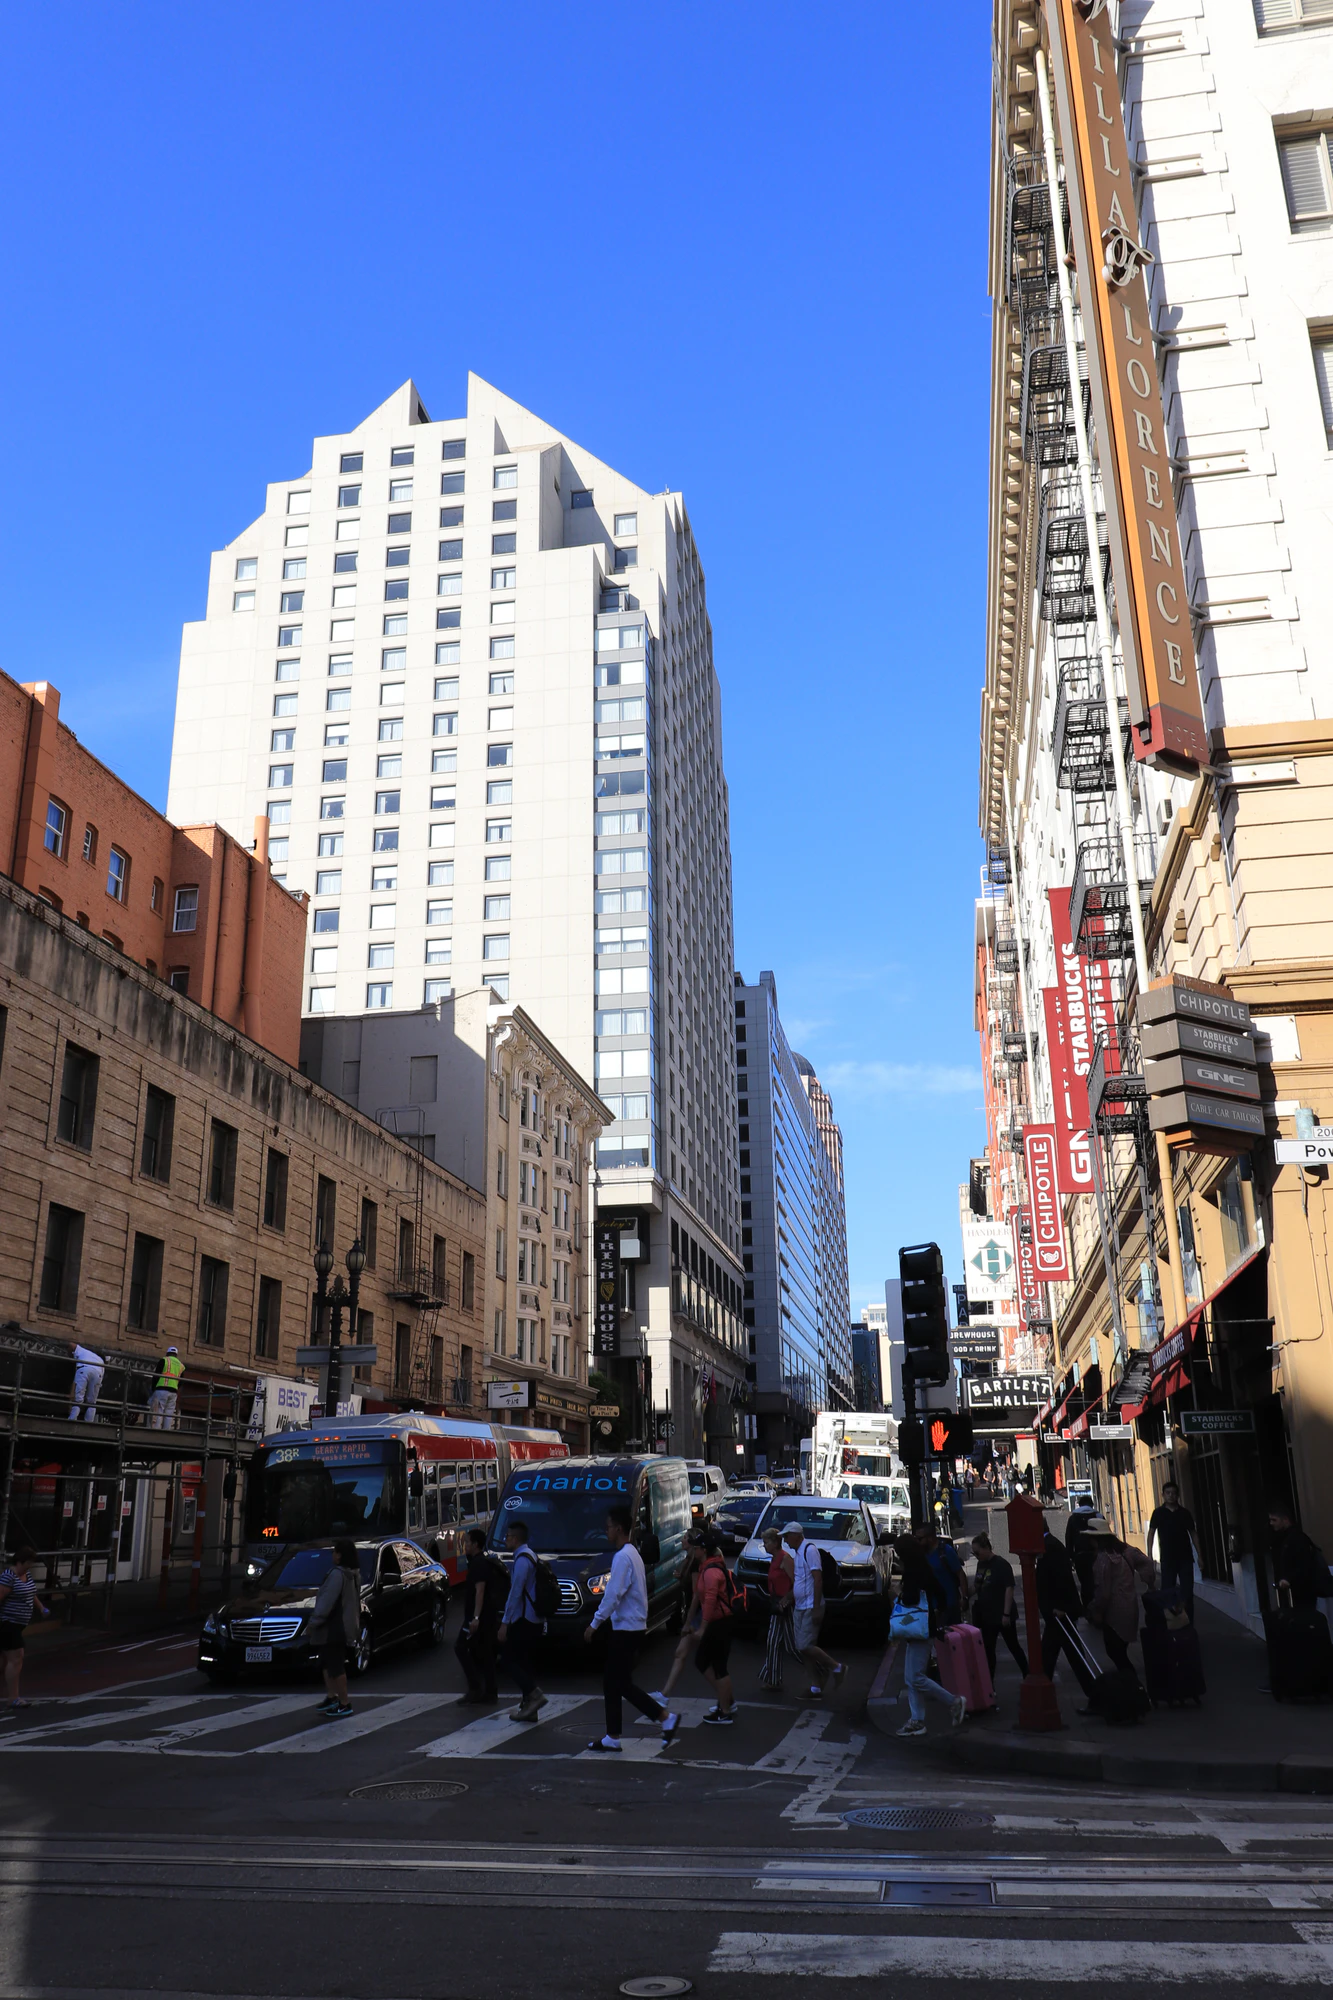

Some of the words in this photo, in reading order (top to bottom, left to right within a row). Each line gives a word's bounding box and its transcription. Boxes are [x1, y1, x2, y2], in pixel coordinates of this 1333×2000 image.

[1061, 941, 1091, 1077] STARBUCKS
[1179, 994, 1246, 1021] CHIPOTLE
[1193, 1028, 1239, 1046] STARBUCKS
[1203, 1040, 1232, 1053] COFFEE
[1197, 1068, 1245, 1087] GNC
[1190, 1103, 1213, 1116] CABLE
[1215, 1108, 1230, 1119] CAR
[1232, 1111, 1260, 1124] TAILORS
[1317, 1128, 1333, 1137] 20
[1033, 1141, 1055, 1240] CHIPOTLE
[599, 1232, 616, 1280] IRISH
[971, 1284, 1011, 1294] HOTE
[599, 1303, 616, 1351] HOUSE
[971, 1379, 1050, 1397] BARTLETT
[278, 1388, 307, 1409] BEST
[993, 1395, 1029, 1406] HALL
[315, 1445, 340, 1455] GEARY
[342, 1443, 367, 1453] RAPID
[513, 1474, 628, 1492] chariot
[261, 1527, 279, 1538] 471
